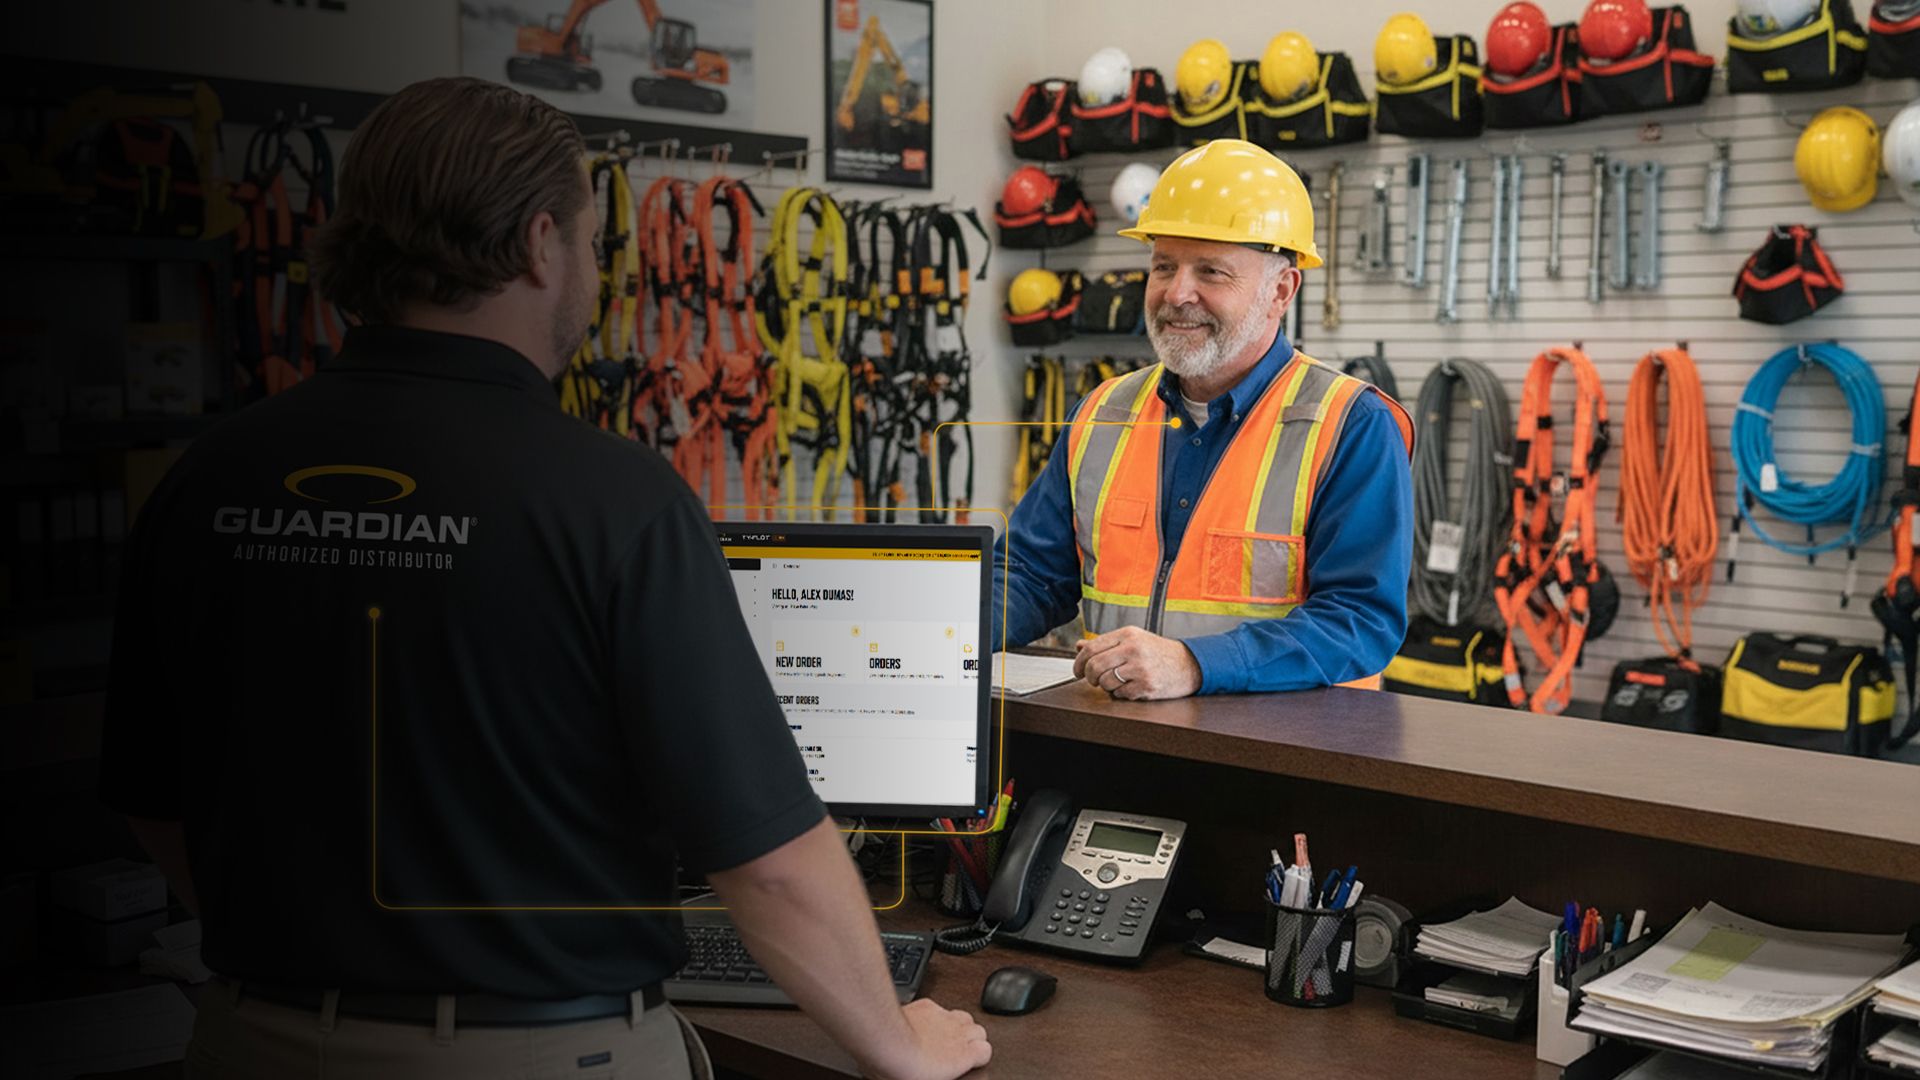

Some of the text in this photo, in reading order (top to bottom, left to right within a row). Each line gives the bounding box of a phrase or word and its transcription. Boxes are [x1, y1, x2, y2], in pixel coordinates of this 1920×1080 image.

[233, 543, 453, 570] AUTHORIZED DISTRIBUTOR
[772, 588, 855, 602] HELLO, ALEX DUMAS!
[776, 656, 822, 669] NEW ORDER
[869, 657, 901, 670] ORDERS
[796, 695, 820, 705] ORDERS
